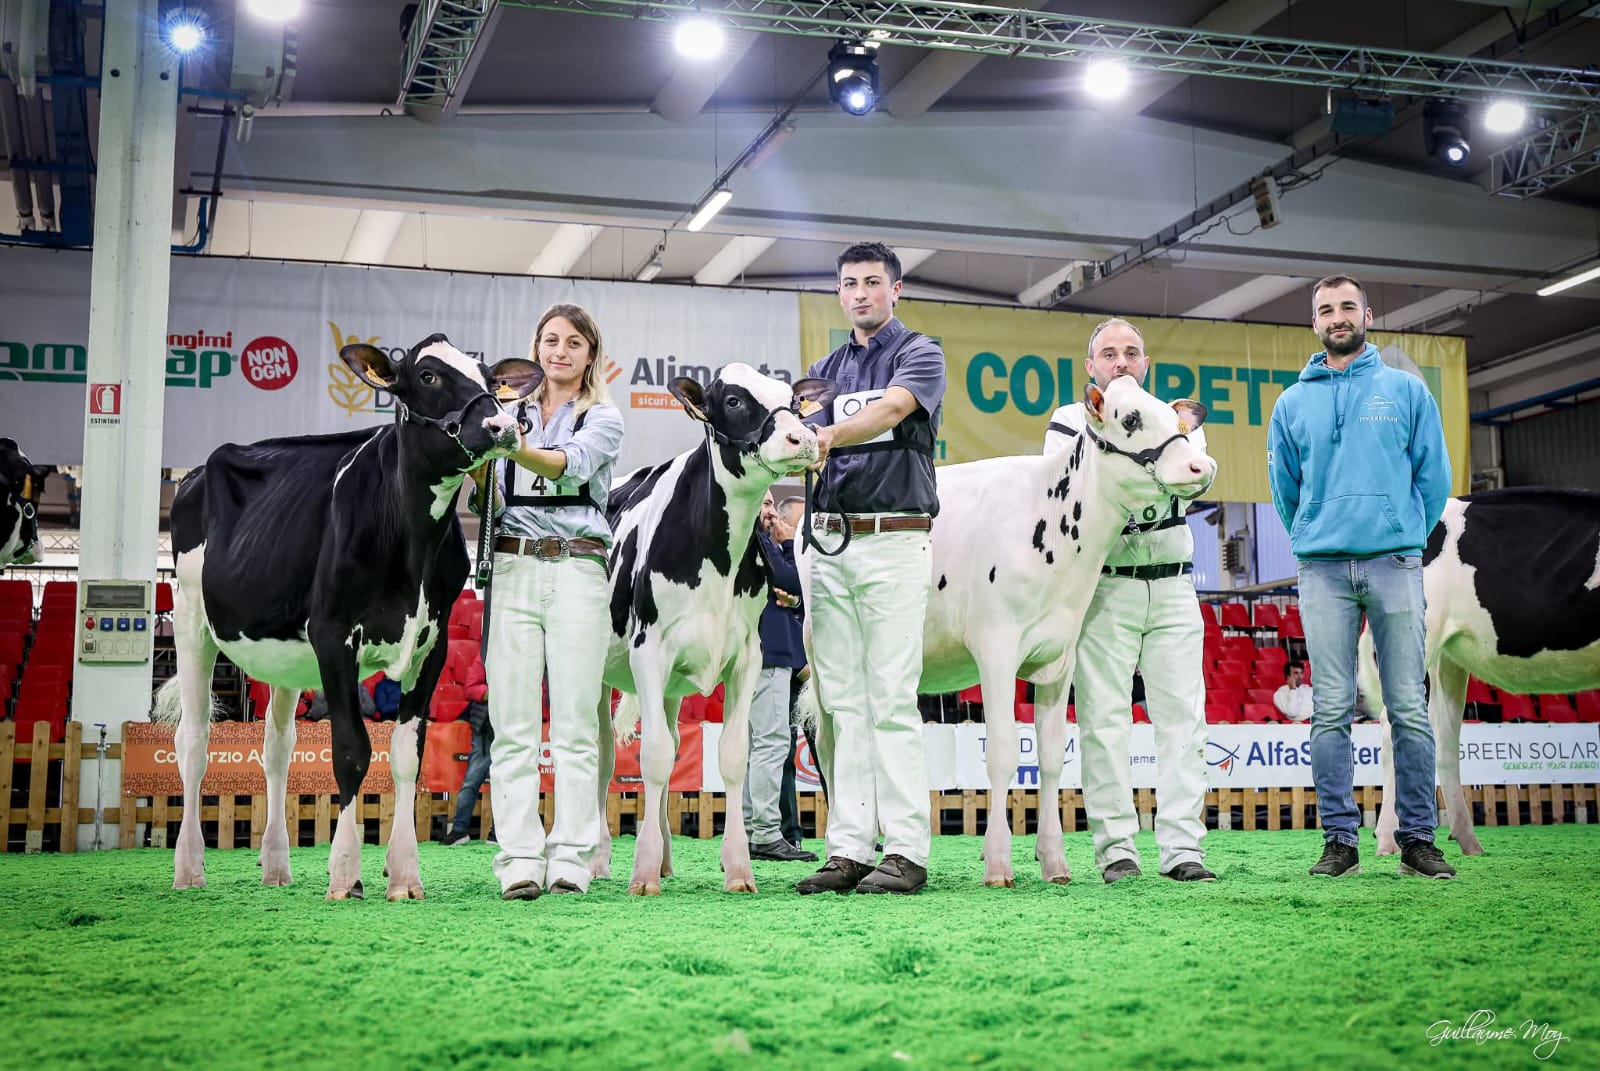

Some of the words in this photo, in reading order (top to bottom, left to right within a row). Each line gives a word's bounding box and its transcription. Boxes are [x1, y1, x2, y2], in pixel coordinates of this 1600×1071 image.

[246, 345, 289, 367] NON
[250, 361, 291, 382] OGM
[630, 355, 792, 386] Alimta
[153, 749, 244, 764] Corzio
[1529, 742, 1599, 759] SOLAR
